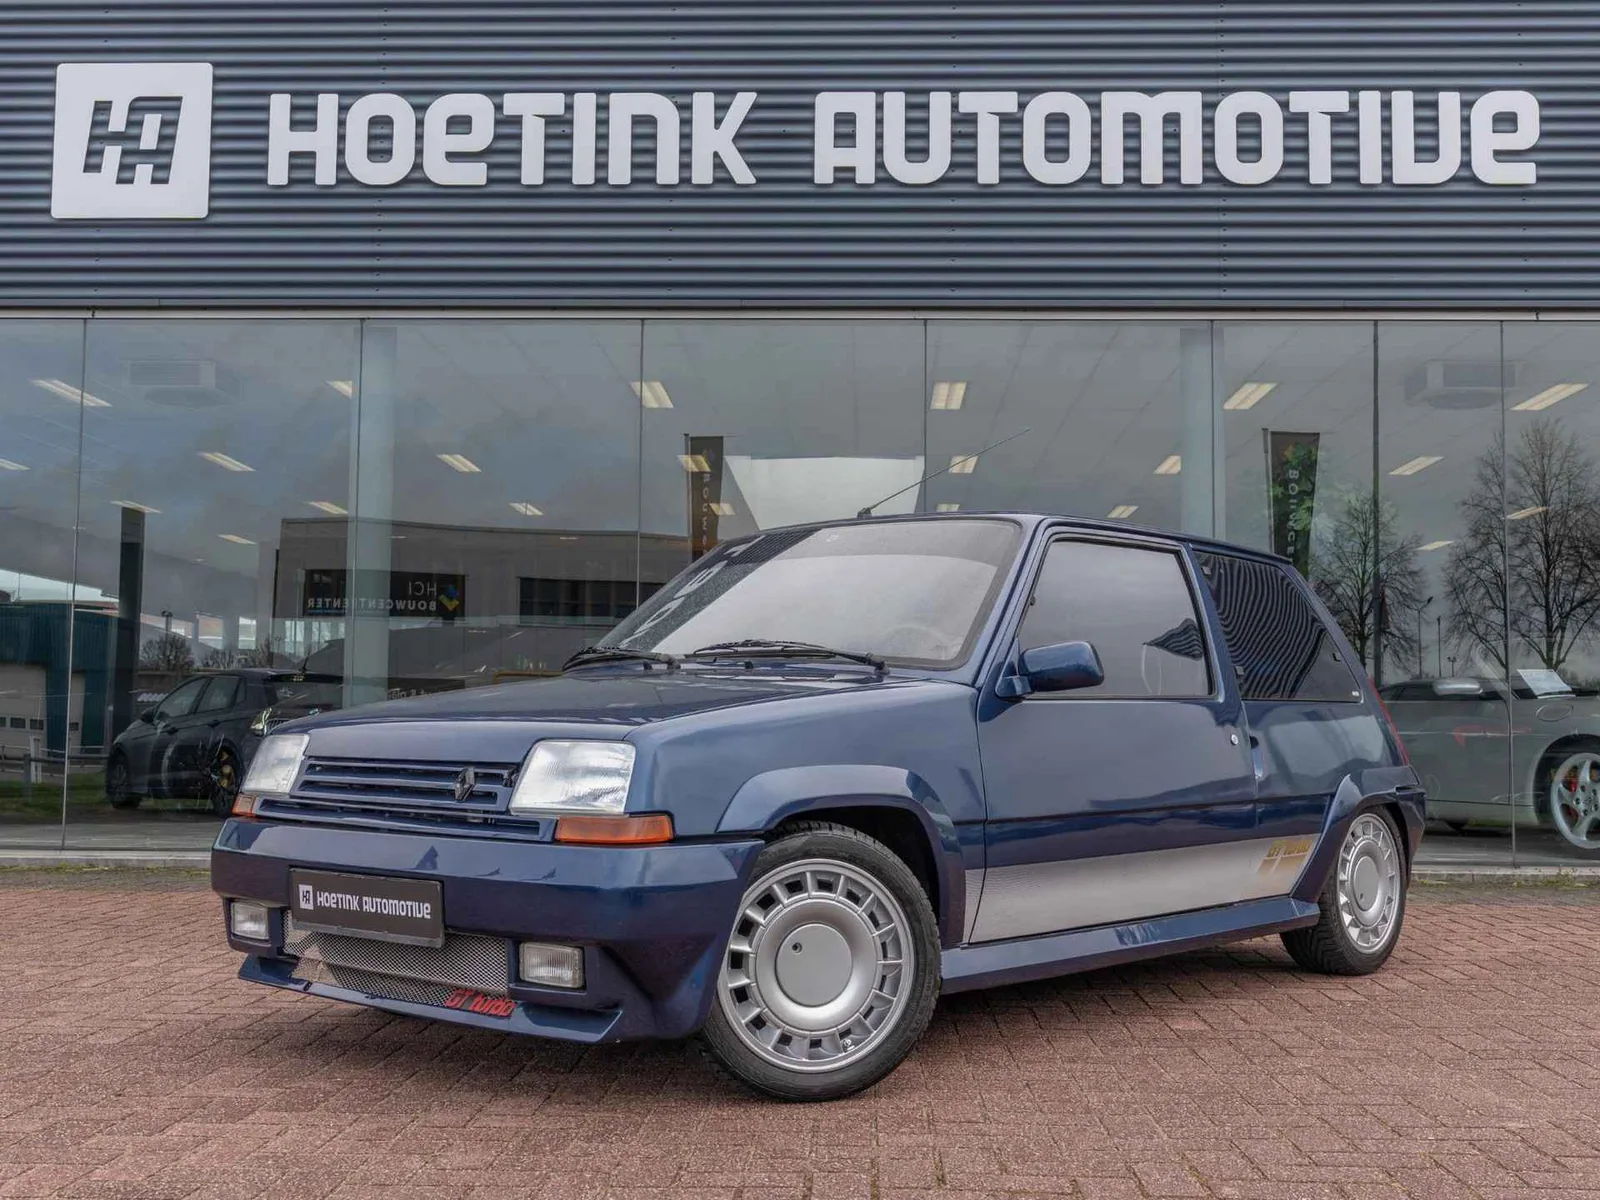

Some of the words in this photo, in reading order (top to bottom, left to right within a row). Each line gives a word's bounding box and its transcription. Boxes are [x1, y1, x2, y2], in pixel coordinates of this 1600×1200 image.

[267, 92, 757, 186] HOETINK
[813, 90, 1541, 185] AUTOMOTIVE
[316, 890, 361, 912] HOETINK
[362, 896, 432, 919] AUTOMOTIVE
